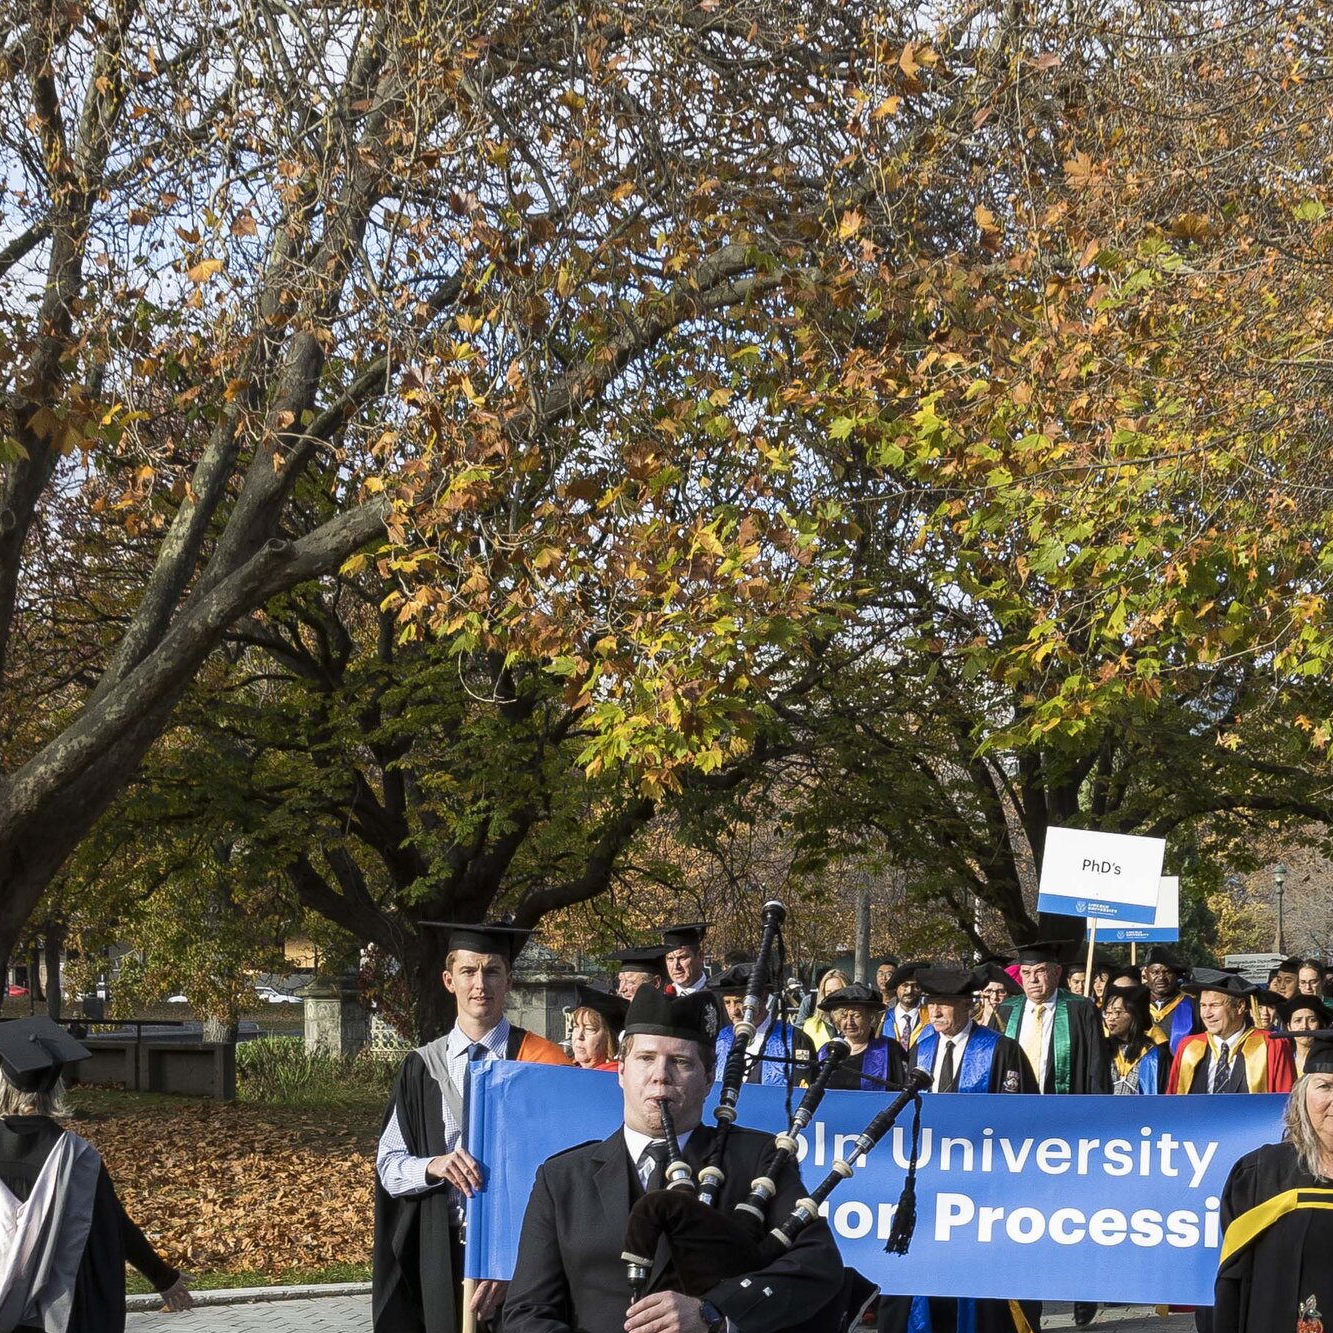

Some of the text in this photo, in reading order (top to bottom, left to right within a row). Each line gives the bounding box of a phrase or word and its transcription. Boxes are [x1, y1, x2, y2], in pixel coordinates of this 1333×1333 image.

[1082, 859, 1121, 875] PhD's
[892, 1126, 1219, 1189] University
[934, 1192, 1221, 1249] Processi
